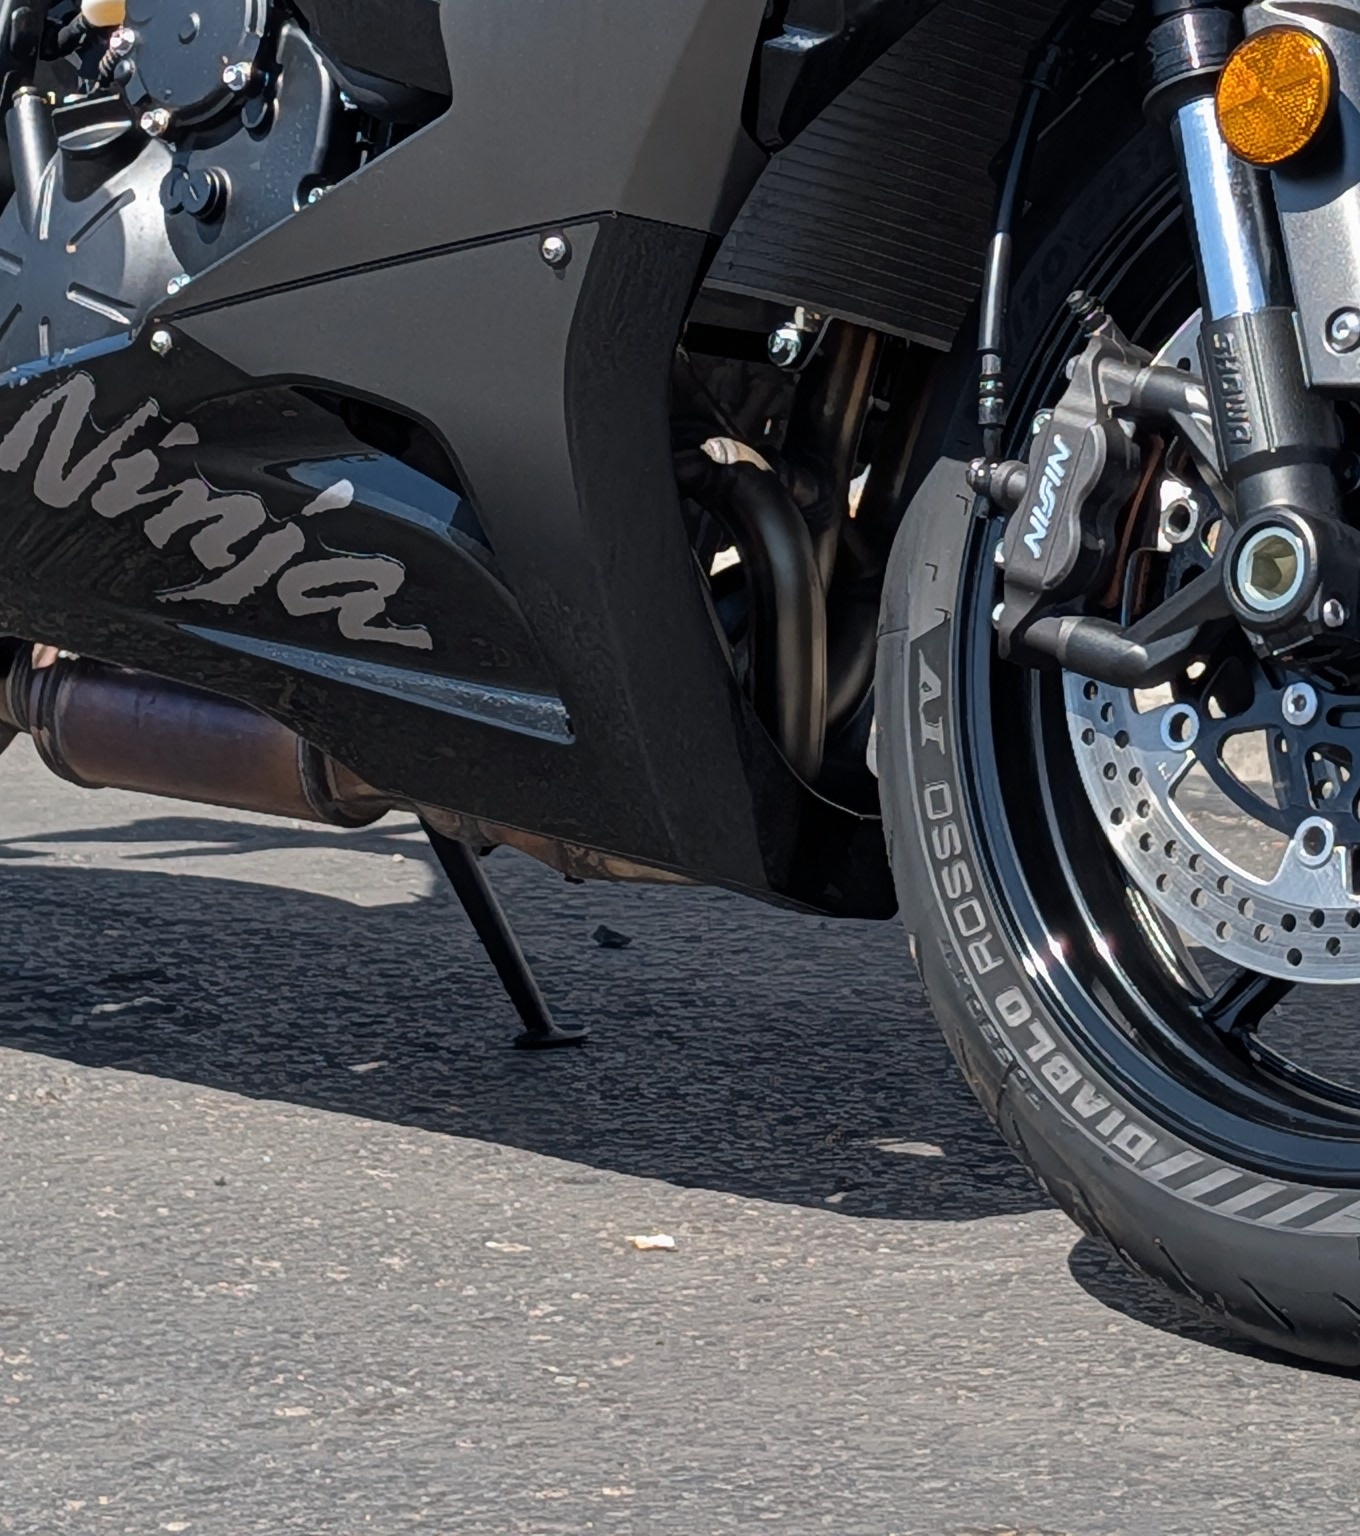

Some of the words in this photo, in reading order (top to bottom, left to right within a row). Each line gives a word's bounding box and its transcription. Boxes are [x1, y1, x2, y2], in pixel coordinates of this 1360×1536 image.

[1021, 434, 1073, 559] NISSIN
[922, 779, 1005, 975] ROSSO
[994, 985, 1158, 1165] DIABLO
